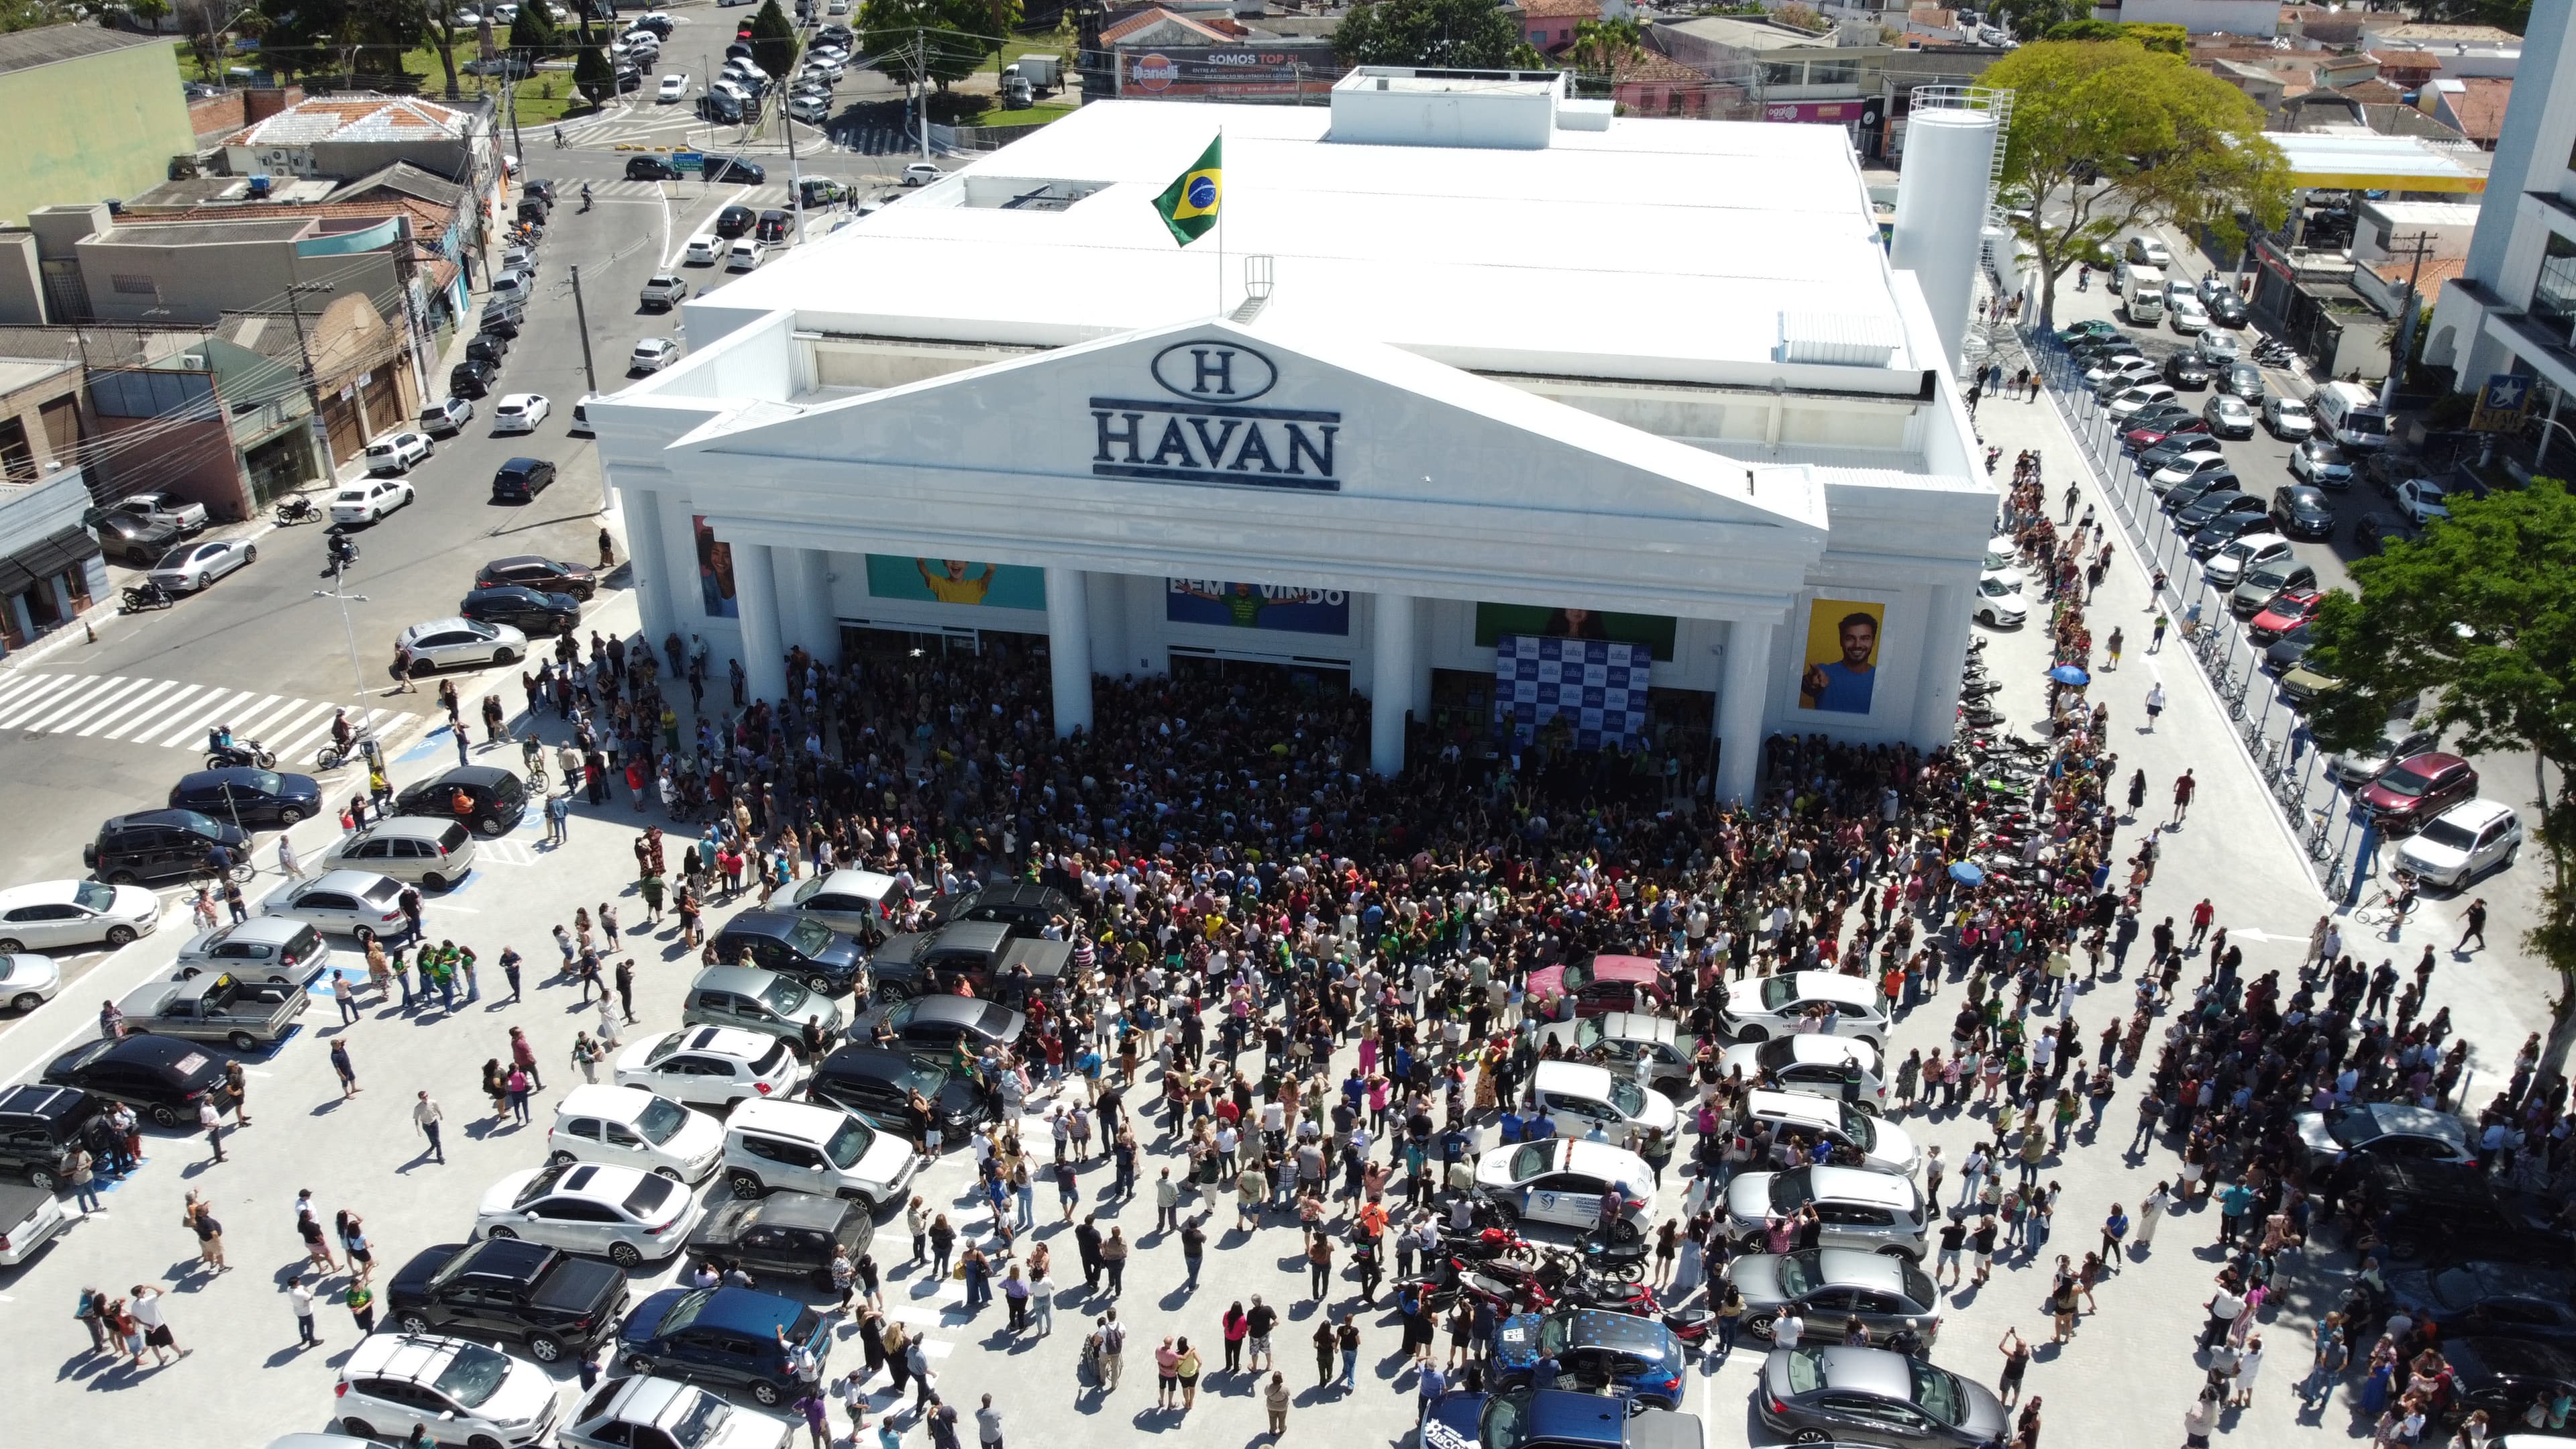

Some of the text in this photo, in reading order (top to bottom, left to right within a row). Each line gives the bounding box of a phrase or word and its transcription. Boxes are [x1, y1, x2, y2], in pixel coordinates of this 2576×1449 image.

[1208, 54, 1256, 64] SOMOS
[1260, 54, 1283, 64] TOP
[1132, 64, 1179, 80] Danelli
[1768, 106, 1786, 117] oggi
[1190, 350, 1236, 394] H
[1091, 411, 1340, 477] HAVAN
[1260, 584, 1345, 606] VINDO
[1449, 1143, 1458, 1152] 10
